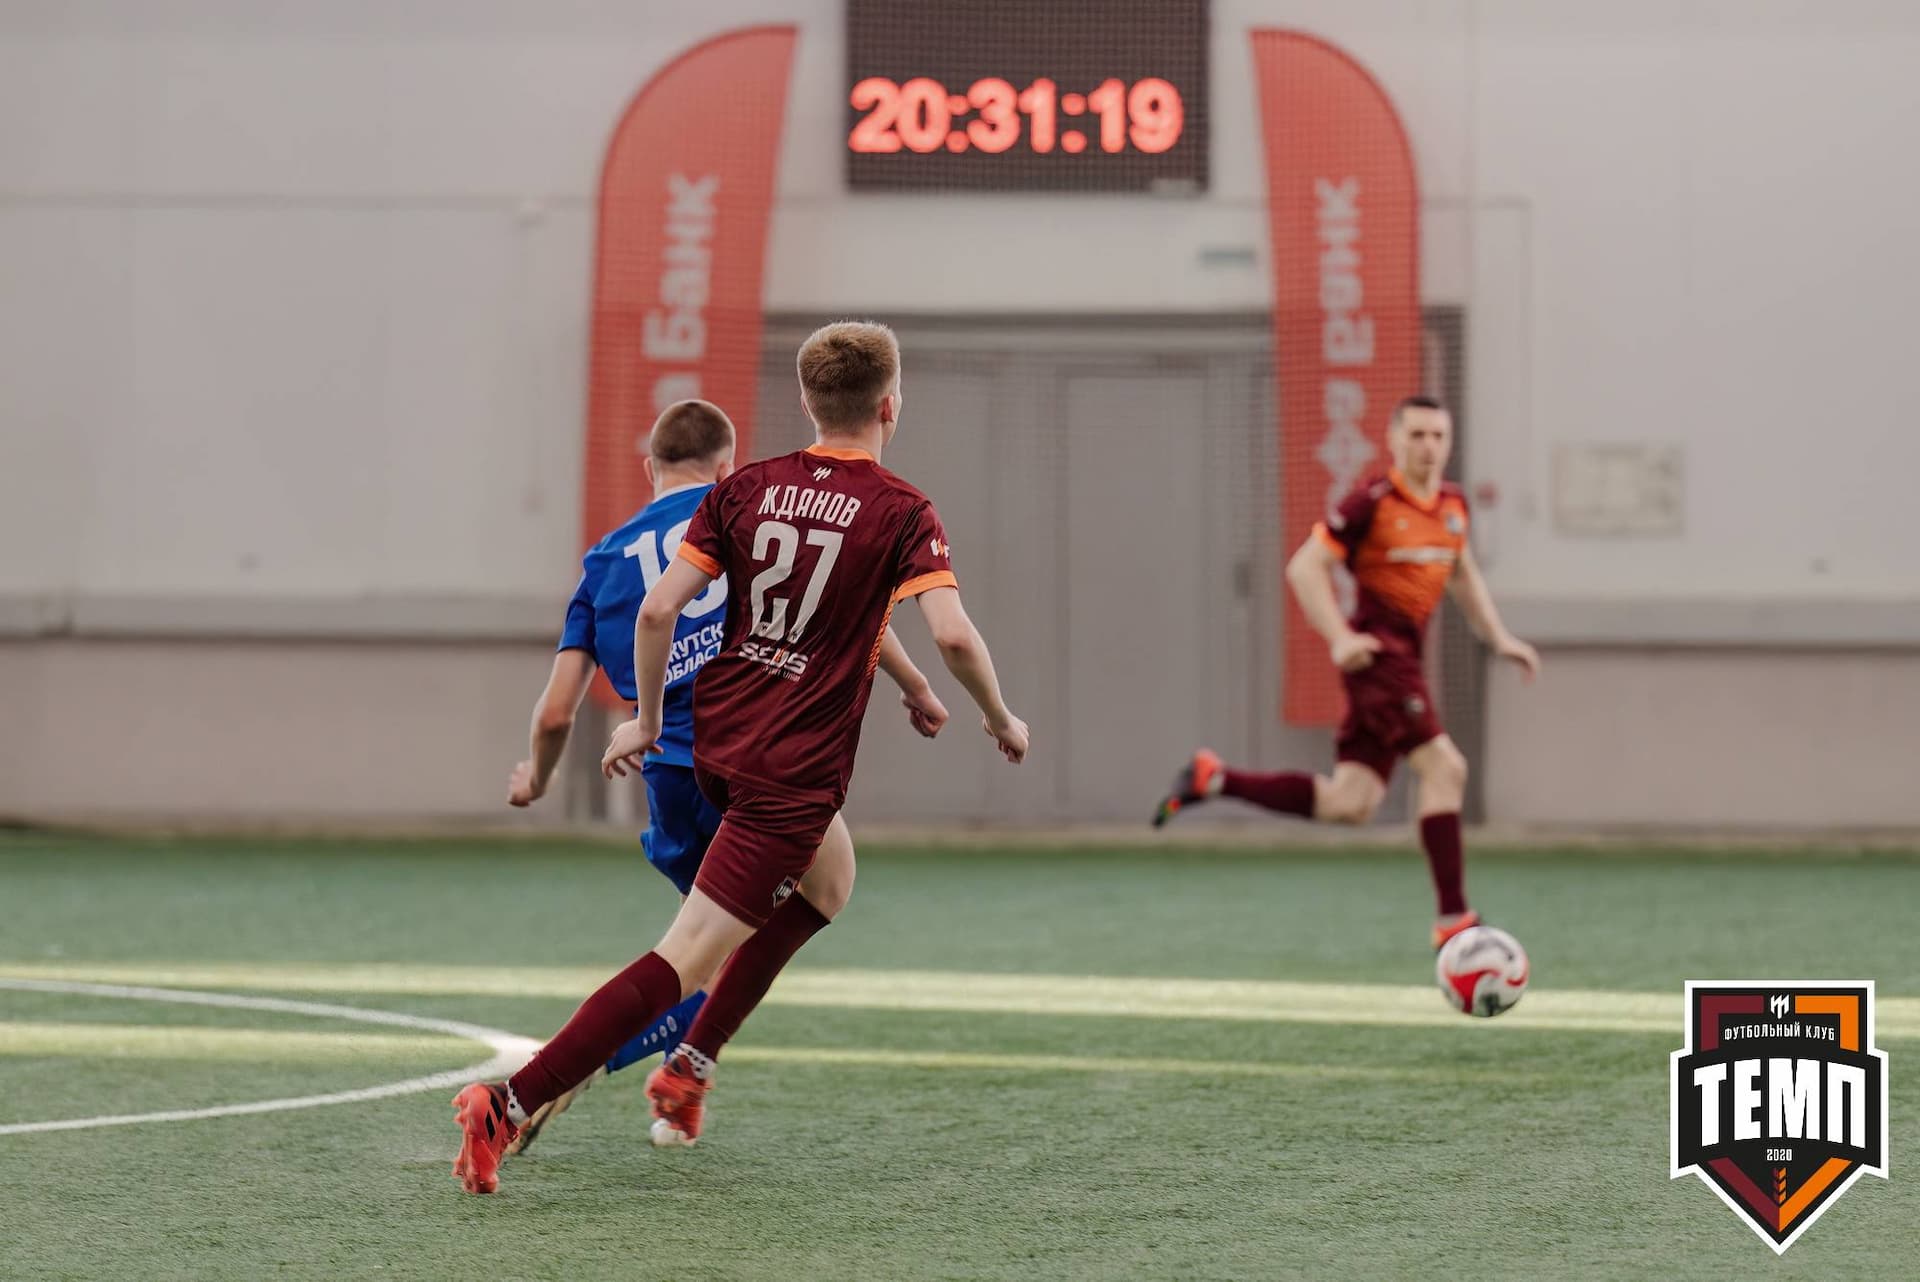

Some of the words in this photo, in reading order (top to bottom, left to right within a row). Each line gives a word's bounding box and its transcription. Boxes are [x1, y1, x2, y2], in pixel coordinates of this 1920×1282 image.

[848, 76, 1184, 154] 20:31:19
[641, 173, 719, 360] Банк
[757, 484, 862, 528] ЖДАНОВ
[749, 520, 845, 644] 27
